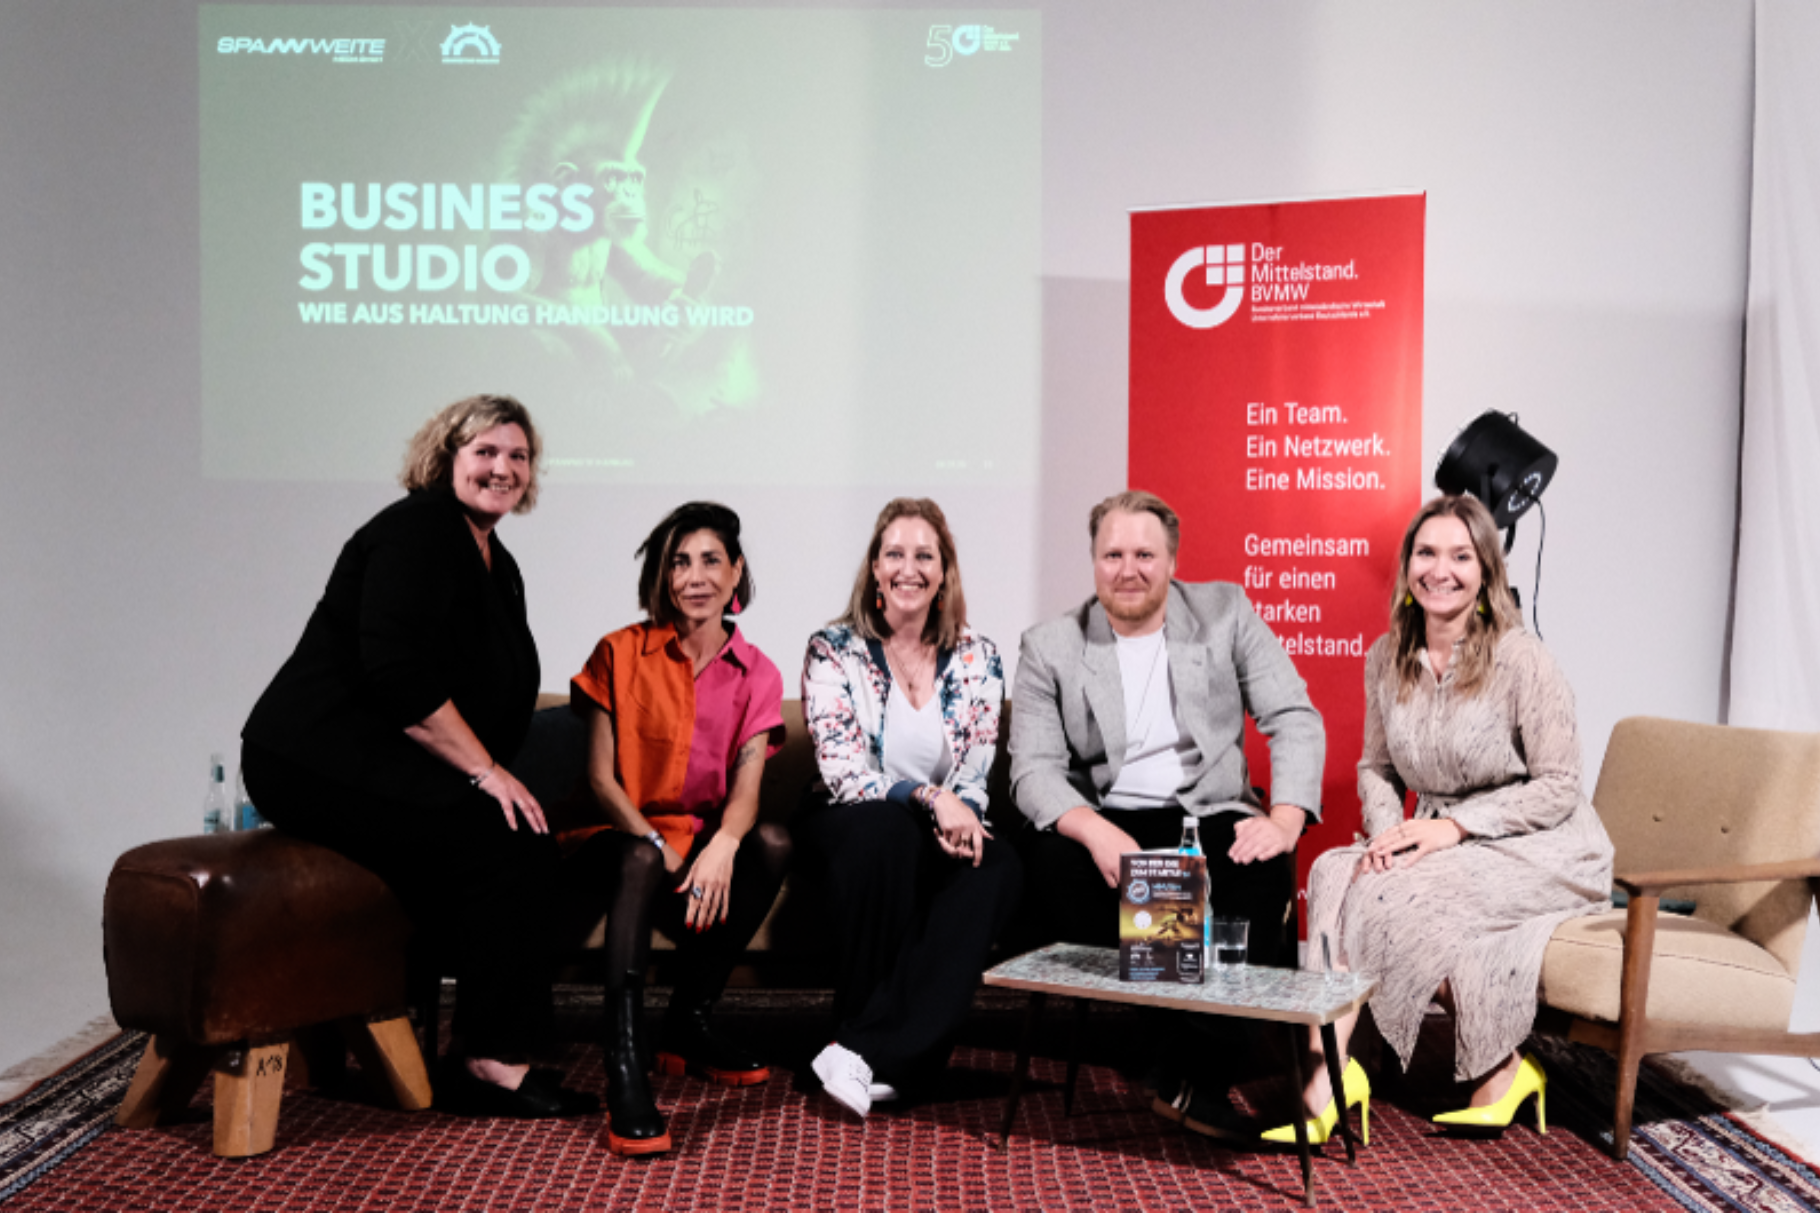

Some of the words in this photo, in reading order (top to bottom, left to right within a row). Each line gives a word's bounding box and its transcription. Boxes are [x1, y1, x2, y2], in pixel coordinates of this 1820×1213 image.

[300, 182, 595, 233] BUSINESS
[1251, 242, 1283, 262] Der
[298, 242, 531, 292] STUDIO
[1251, 258, 1359, 282] Mittelstand.
[1251, 282, 1310, 302] BVMW
[298, 302, 348, 324] WIE
[352, 302, 405, 325] AUS
[409, 303, 530, 325] HALTUNG
[535, 304, 680, 327] HANDLUNG
[684, 305, 755, 327] WIRD
[1246, 402, 1278, 426] Ein
[1284, 402, 1348, 424] Team.
[1246, 434, 1277, 458] Ein
[1284, 432, 1391, 458] Netzwerk.
[1246, 467, 1290, 491] Eine
[1297, 467, 1386, 490] Mission.
[1244, 533, 1370, 557] Gemeinsam
[1244, 565, 1273, 589] für
[1278, 566, 1336, 590] einen
[1253, 598, 1322, 623] tarken
